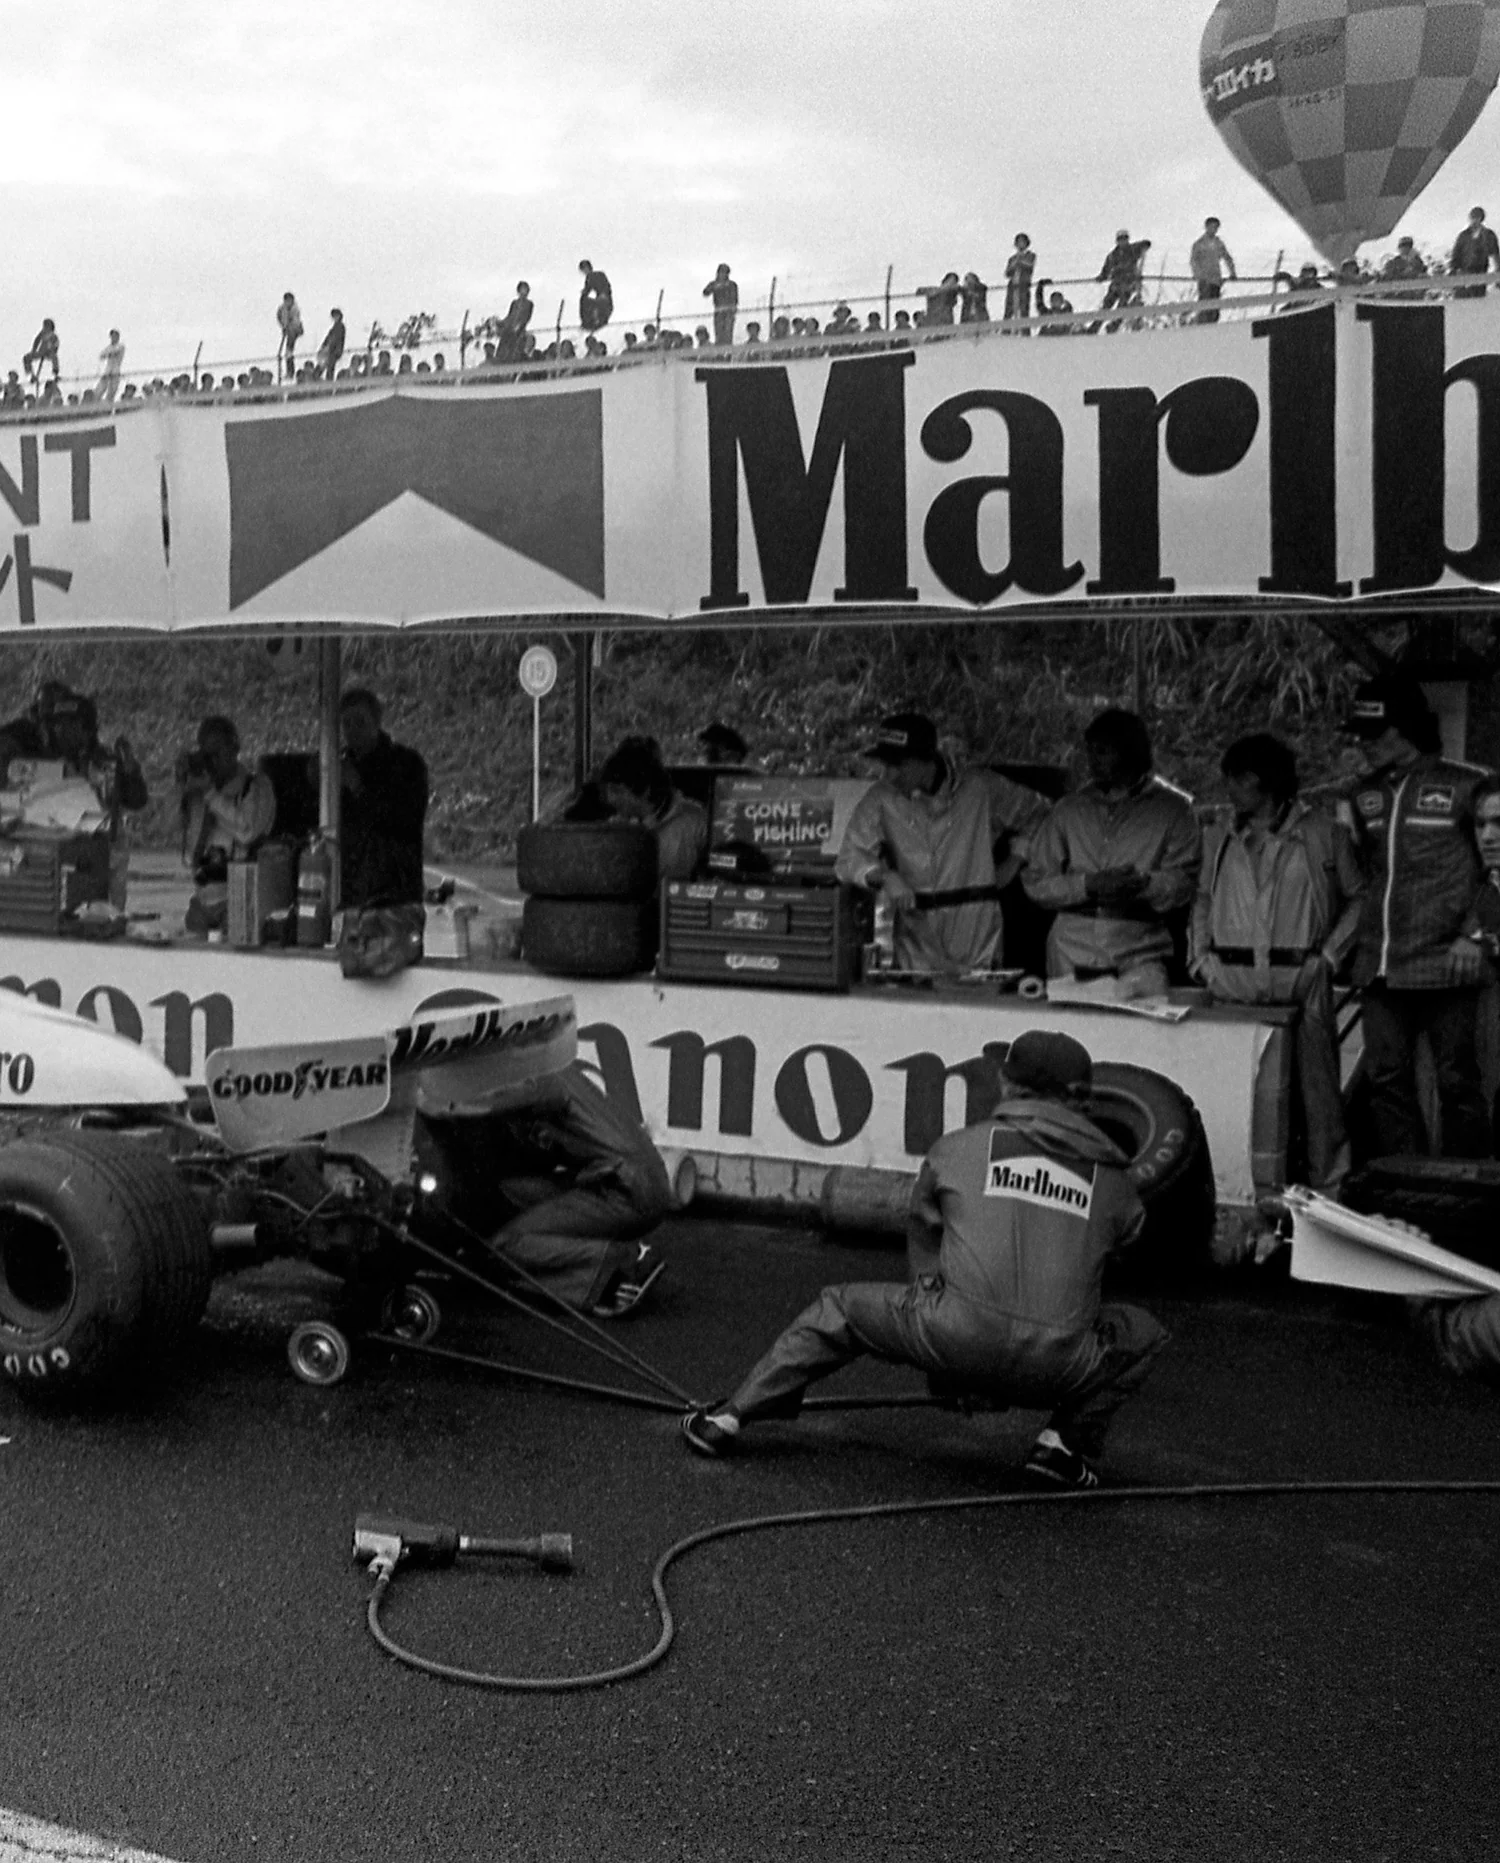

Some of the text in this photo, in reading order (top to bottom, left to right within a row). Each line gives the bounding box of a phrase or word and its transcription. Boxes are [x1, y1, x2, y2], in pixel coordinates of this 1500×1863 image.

[743, 802, 803, 821] GONE
[753, 821, 831, 843] FISHING
[992, 1166, 1088, 1209] Marlboro
